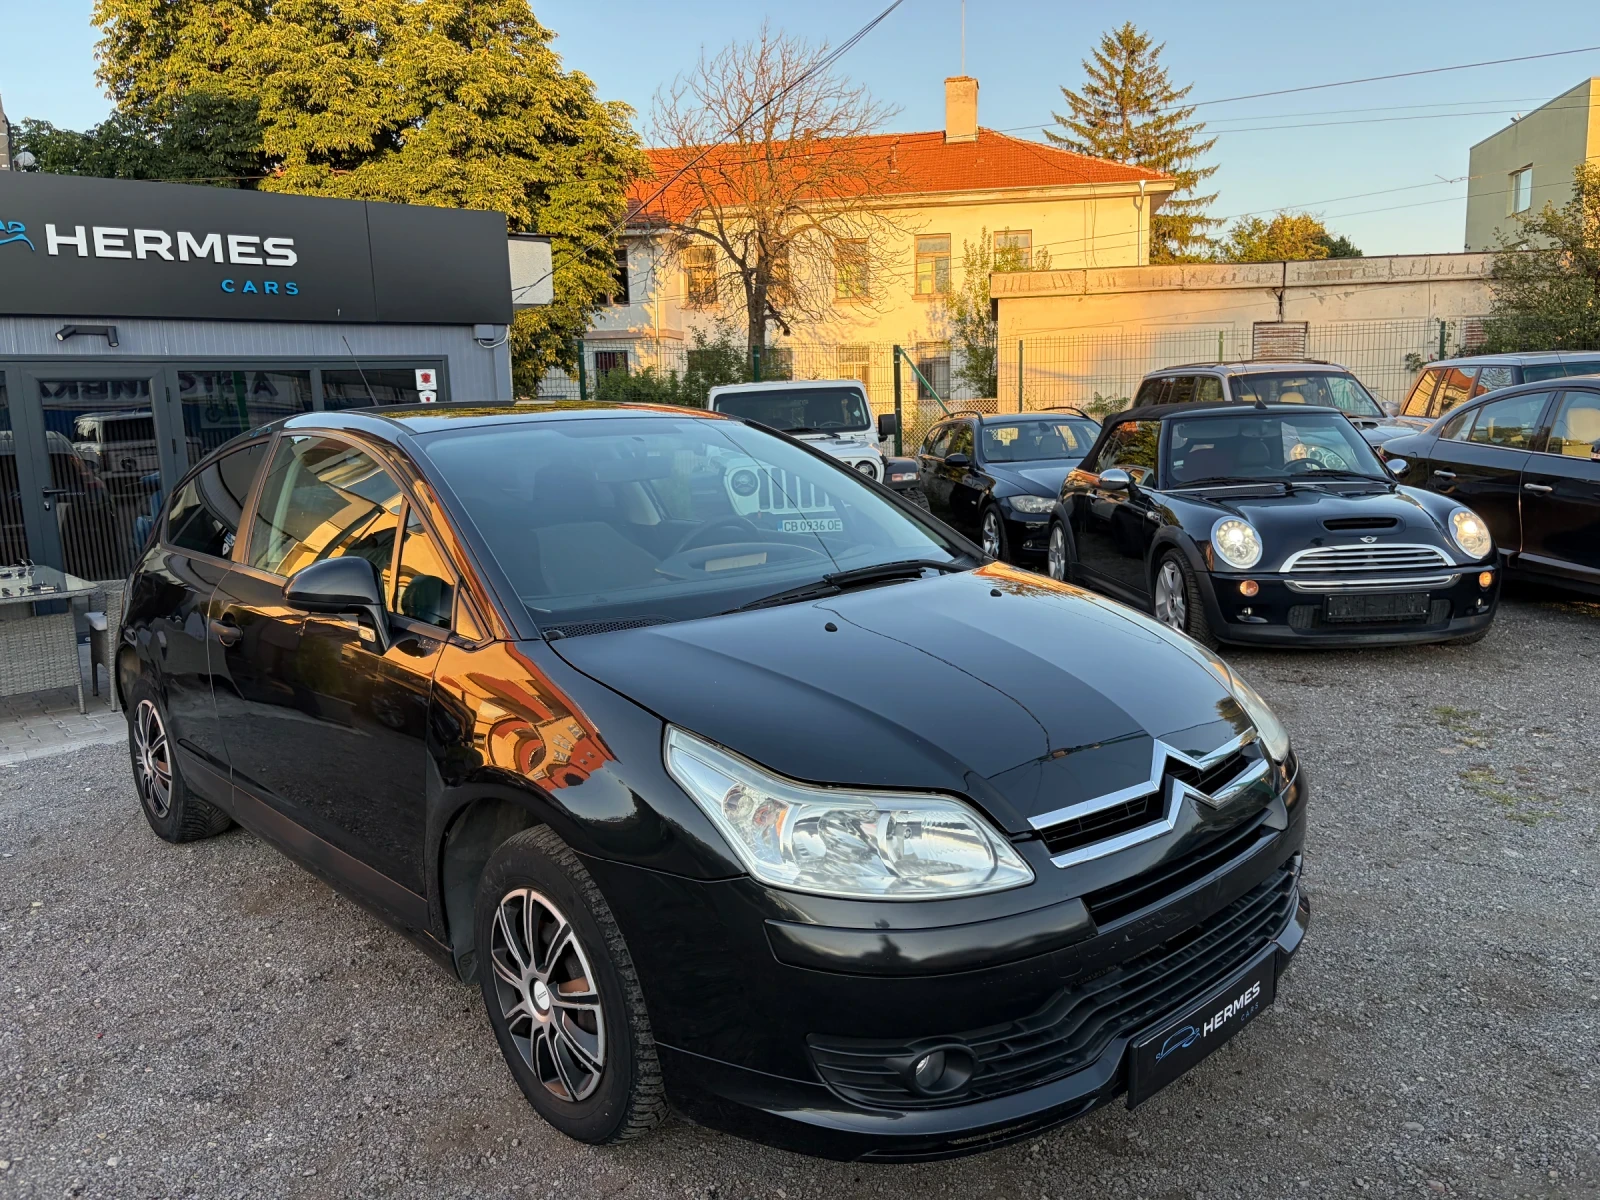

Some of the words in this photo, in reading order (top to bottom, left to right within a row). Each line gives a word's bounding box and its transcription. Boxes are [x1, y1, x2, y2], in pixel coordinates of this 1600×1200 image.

[45, 223, 298, 267] HERMES
[221, 279, 299, 295] CARS
[784, 521, 798, 532] CB
[800, 520, 826, 531] 0936
[1203, 980, 1261, 1038] HERMES
[1240, 1001, 1259, 1021] CARS
